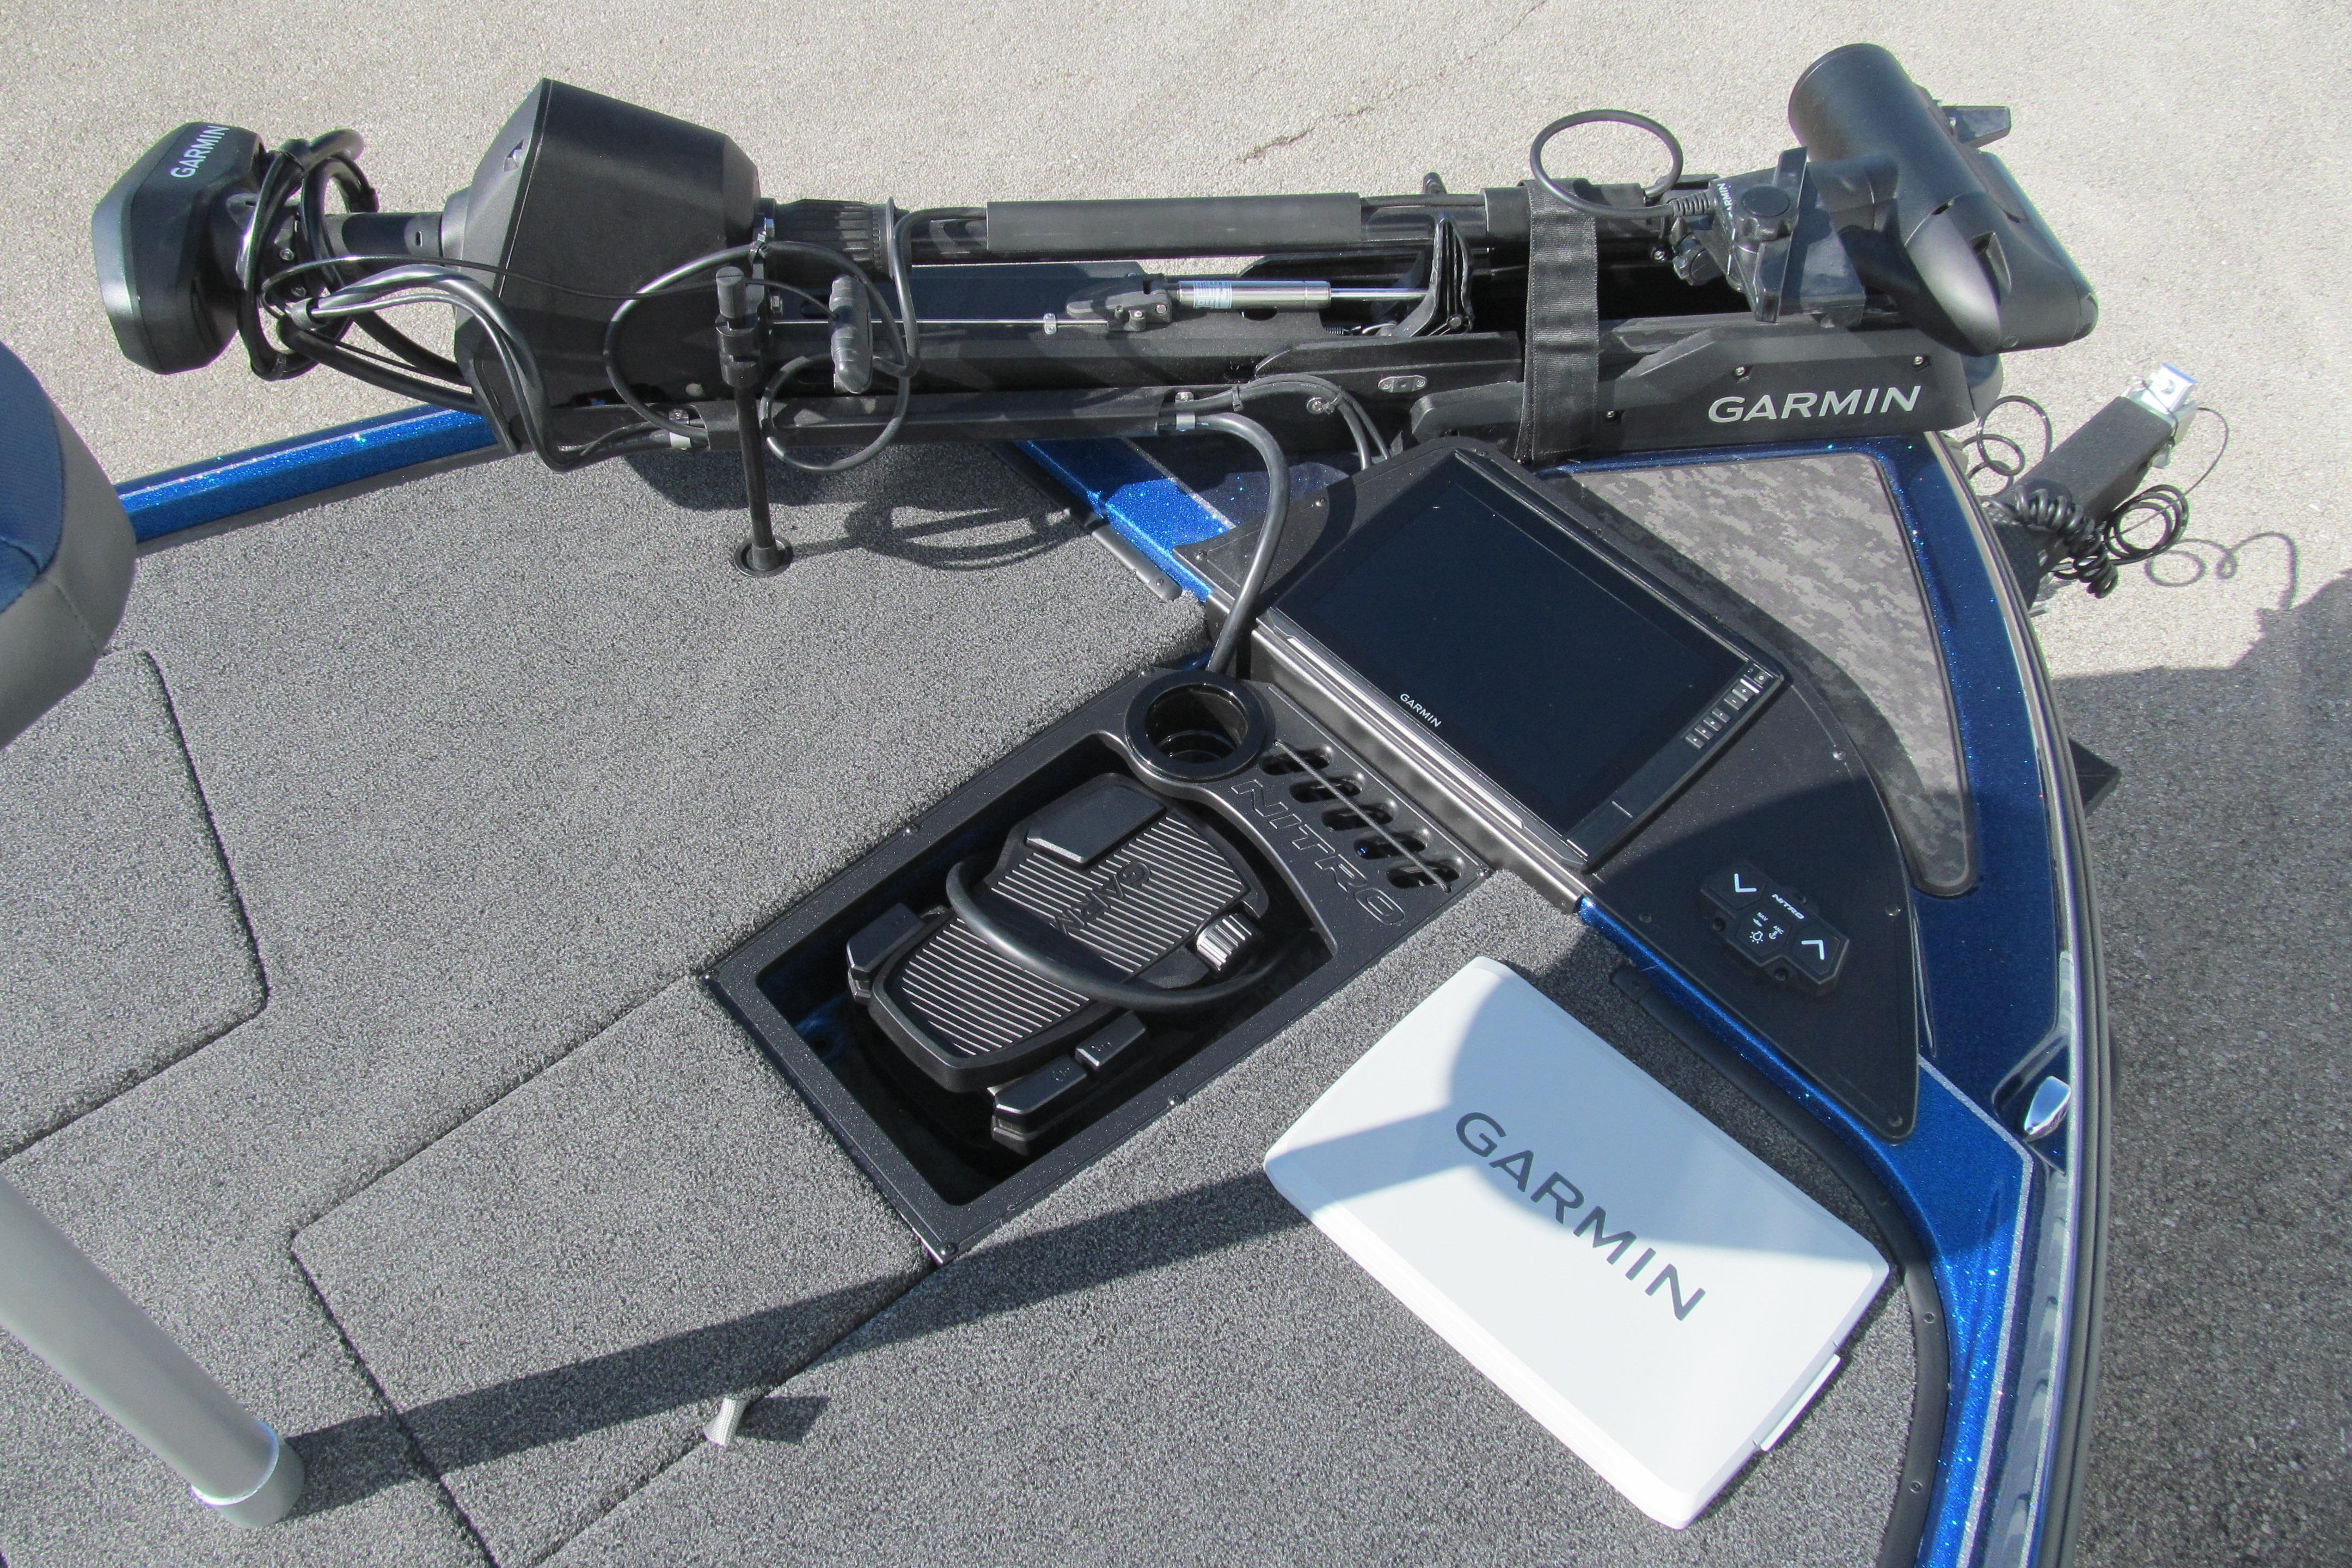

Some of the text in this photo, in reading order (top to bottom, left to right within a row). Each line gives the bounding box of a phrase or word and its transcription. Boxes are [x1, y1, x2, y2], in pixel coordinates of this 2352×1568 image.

[170, 125, 229, 178] GARMIN
[1708, 385, 1921, 423] GARMIN
[1400, 693, 1442, 727] GARMIN
[1230, 779, 1406, 925] NITRO
[1054, 861, 1151, 935] GARM
[1757, 912, 1769, 921] NAV
[1772, 893, 1805, 919] NITRO
[1455, 1112, 1706, 1321] GARMIN
